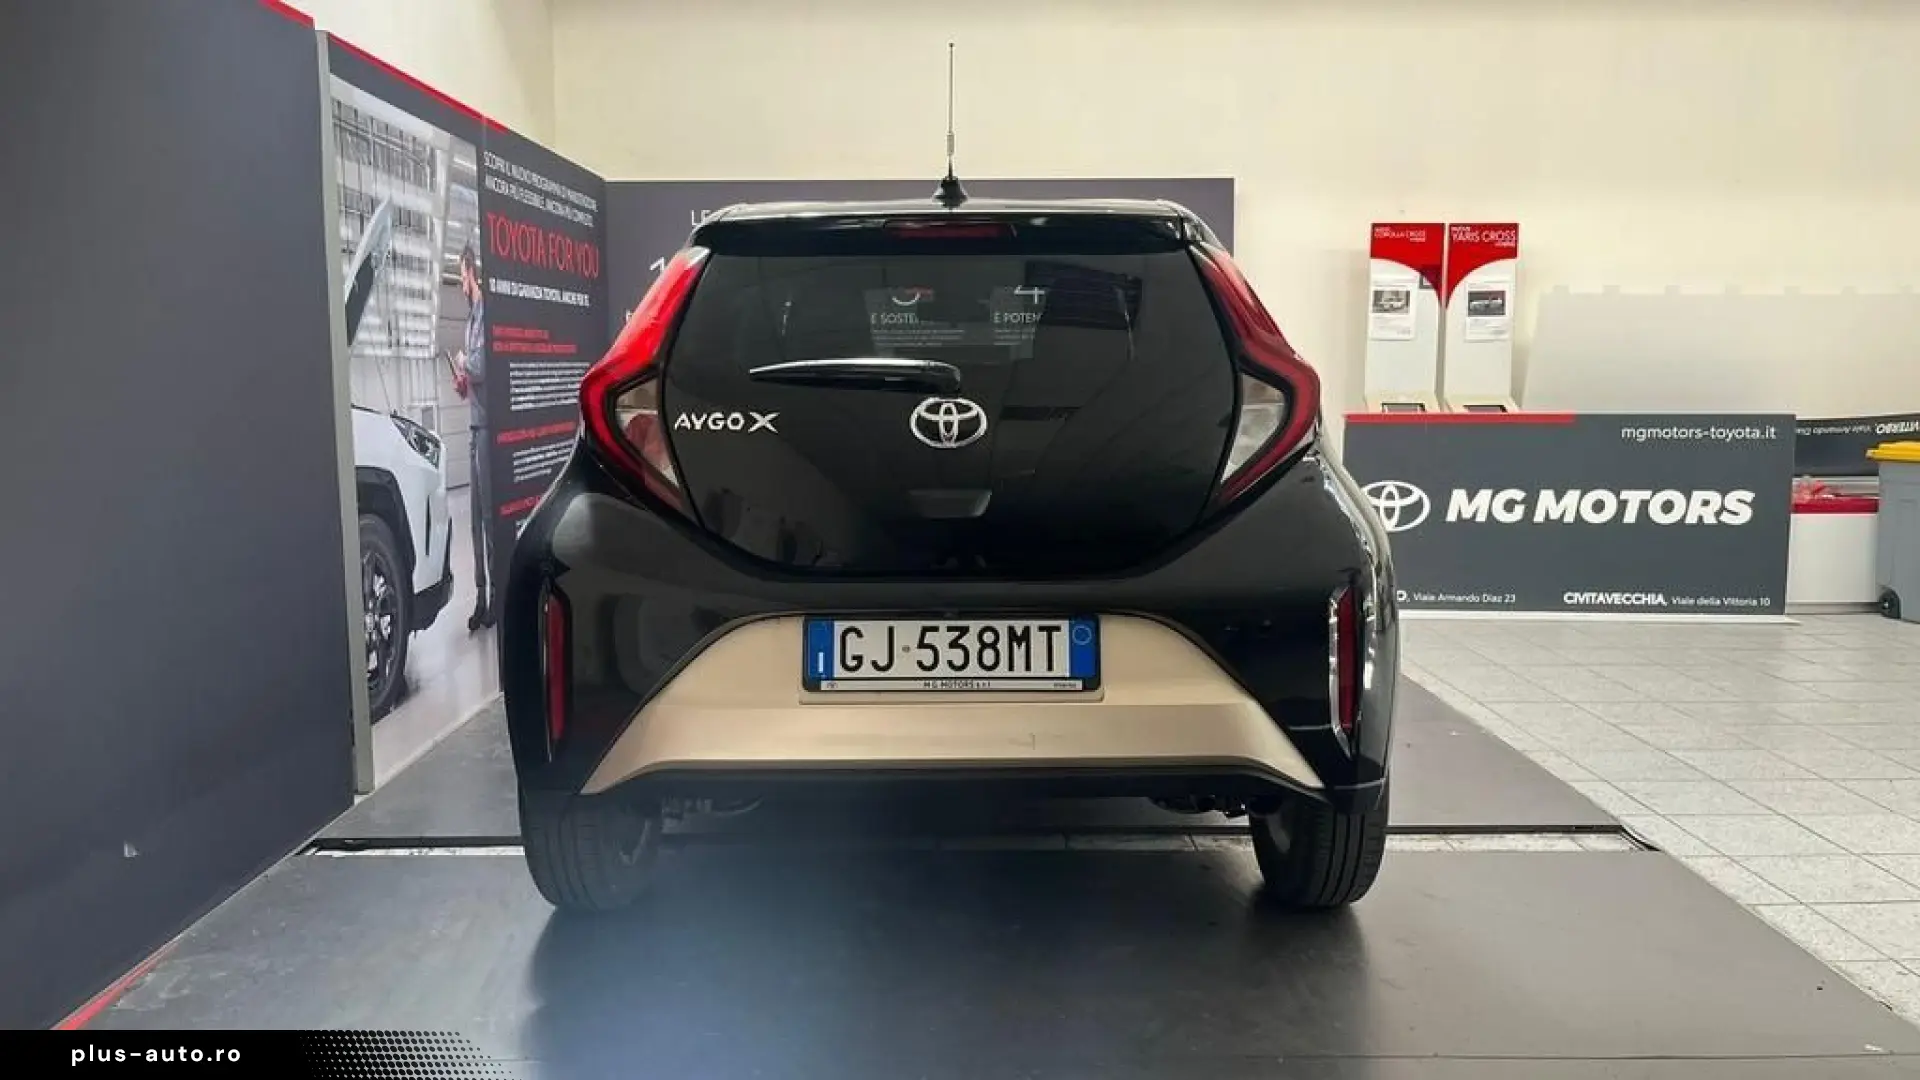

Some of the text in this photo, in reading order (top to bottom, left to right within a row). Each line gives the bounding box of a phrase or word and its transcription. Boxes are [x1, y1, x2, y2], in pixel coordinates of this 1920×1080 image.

[1452, 230, 1516, 242] YARIS CROSS
[487, 212, 599, 279] TOYOTA FOR YOU
[674, 411, 780, 434] AYGO X
[1621, 424, 1777, 442] mgmotors-toyota.it
[1445, 488, 1756, 525] MG MOTORS
[1413, 592, 1436, 601] Viale
[1438, 592, 1480, 602] Armando
[1482, 593, 1502, 603] Diaz
[1563, 591, 1771, 607] CIVITAVECCHIA, Viale della Vittoria 10
